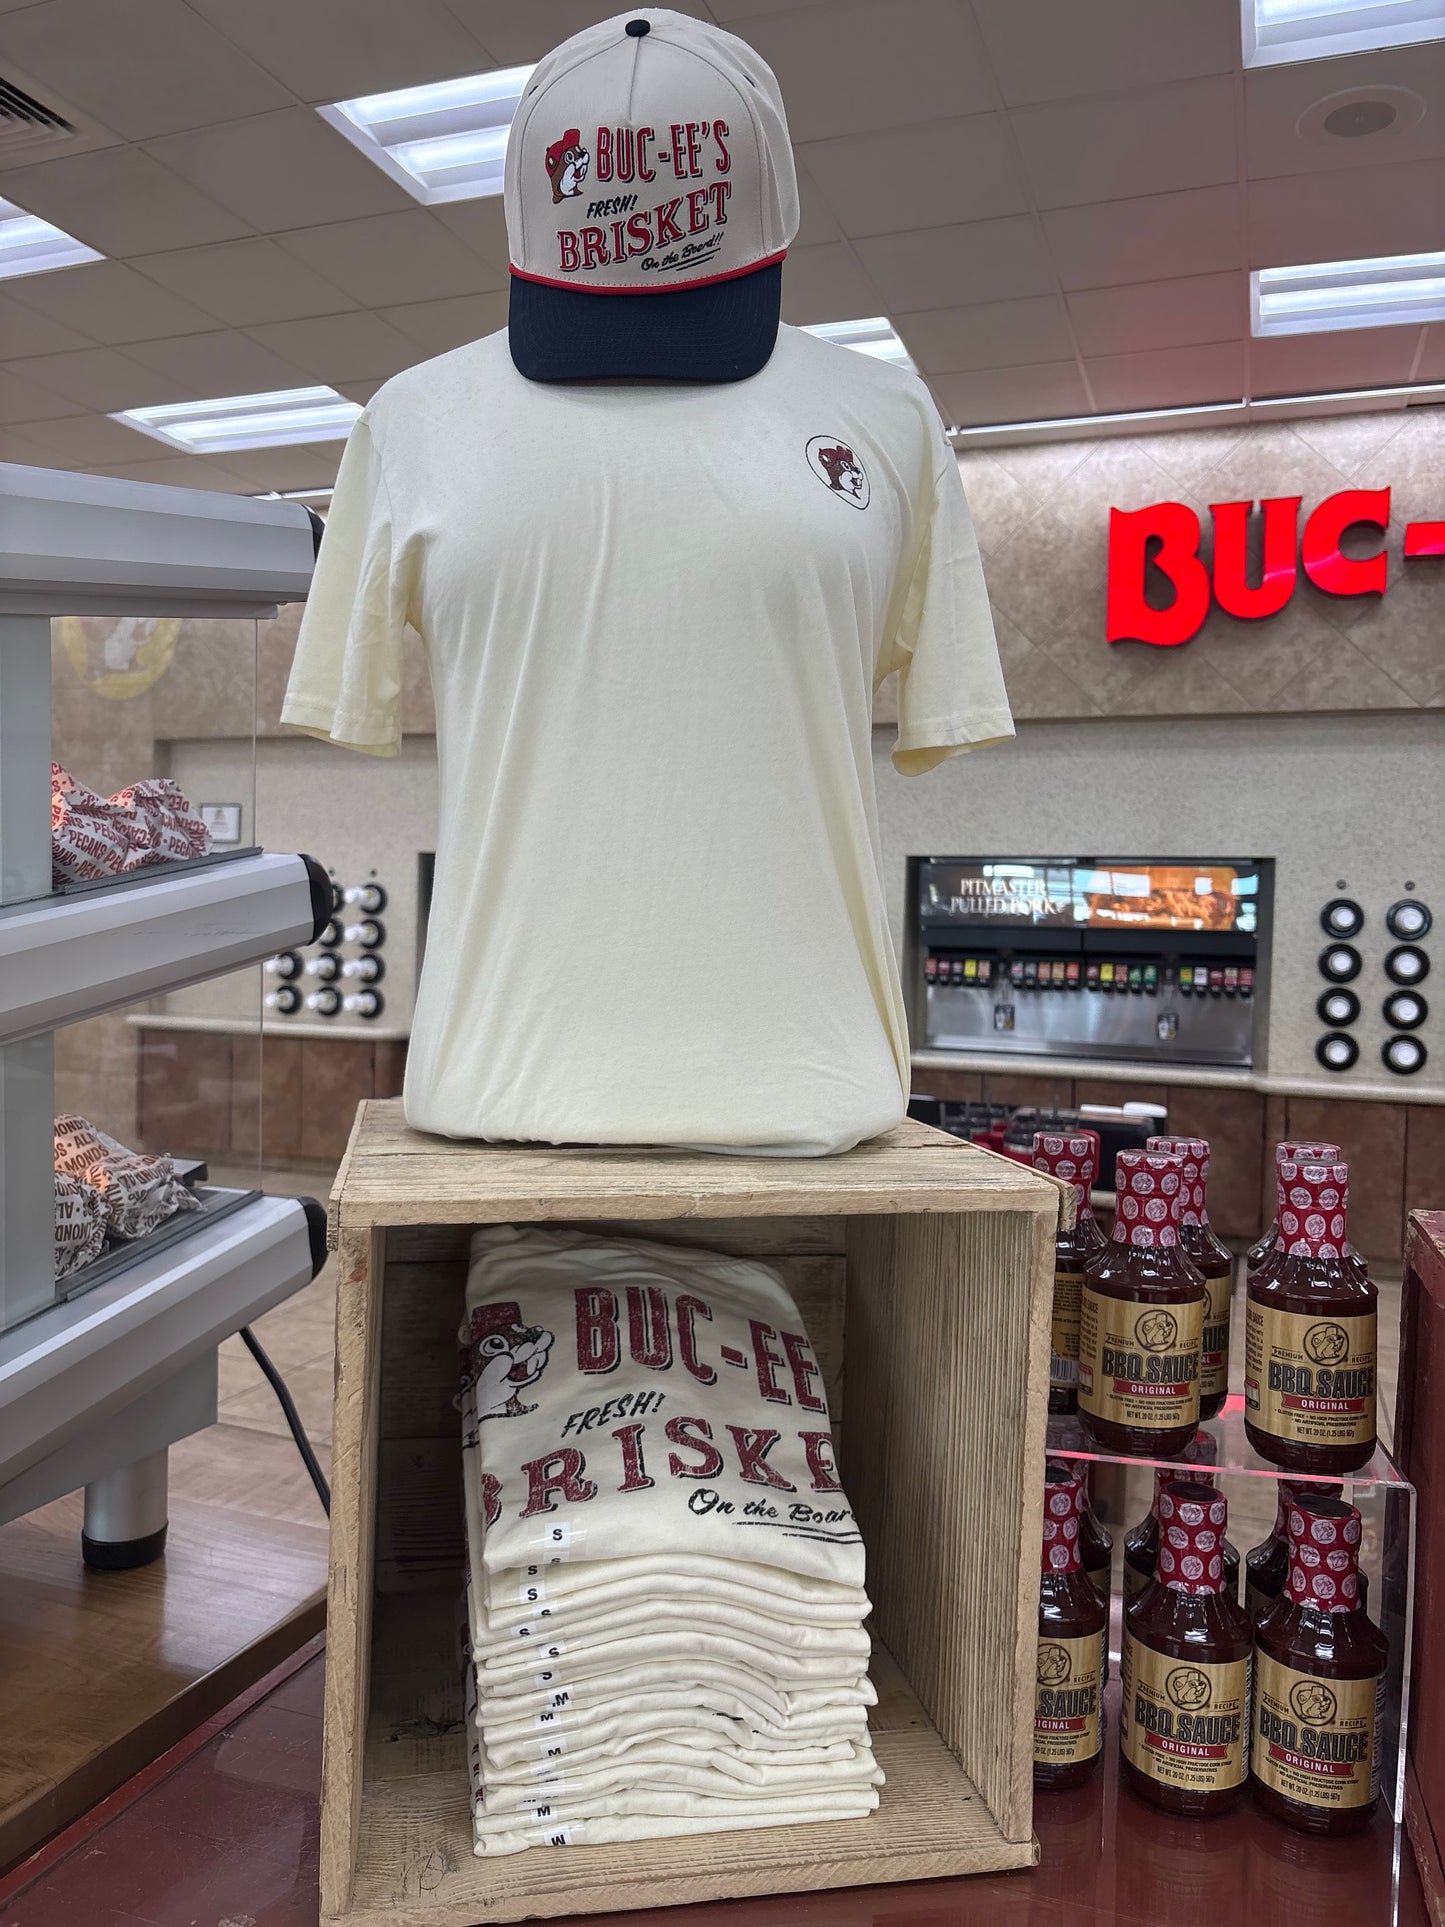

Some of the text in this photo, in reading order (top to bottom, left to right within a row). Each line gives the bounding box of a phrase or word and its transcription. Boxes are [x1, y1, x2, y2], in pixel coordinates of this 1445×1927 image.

[596, 119, 732, 184] BUC-EE'S
[586, 194, 638, 219] FRESH!
[557, 181, 732, 272] BRISKET
[641, 257, 660, 271] On
[661, 251, 679, 266] the
[69, 829, 107, 861] PECANS
[950, 896, 1007, 915] PULLED
[574, 1286, 827, 1415] BUC-EE
[1273, 1348, 1303, 1360] PREMIUM
[1102, 1346, 1145, 1382] BBQ
[1145, 1351, 1199, 1384] SAUCE
[1268, 1360, 1373, 1398] BBQ SAUCE
[1131, 1384, 1176, 1395] ORIGINAL
[561, 1390, 667, 1438] FRESH!
[1301, 1400, 1349, 1410] ORIGINAL
[688, 1488, 735, 1515] On
[742, 1498, 779, 1519] the
[552, 1528, 563, 1541] S
[528, 1565, 538, 1575] S
[527, 1588, 538, 1600] S
[548, 1647, 560, 1657] S
[1039, 1684, 1097, 1718] SAUCE
[1140, 1684, 1236, 1710] PREMIUM RECIPE
[1264, 1694, 1289, 1714] PREMIUM
[540, 1713, 554, 1721] M
[1035, 1719, 1070, 1729] IGINAL
[1135, 1693, 1240, 1745] BBQ SAUCE
[1261, 1705, 1368, 1762] BBQ SAUCE
[547, 1747, 561, 1757] M
[1162, 1740, 1209, 1756] ORIGINAL
[1285, 1753, 1335, 1773] ORIGINAL
[537, 1806, 551, 1817] M
